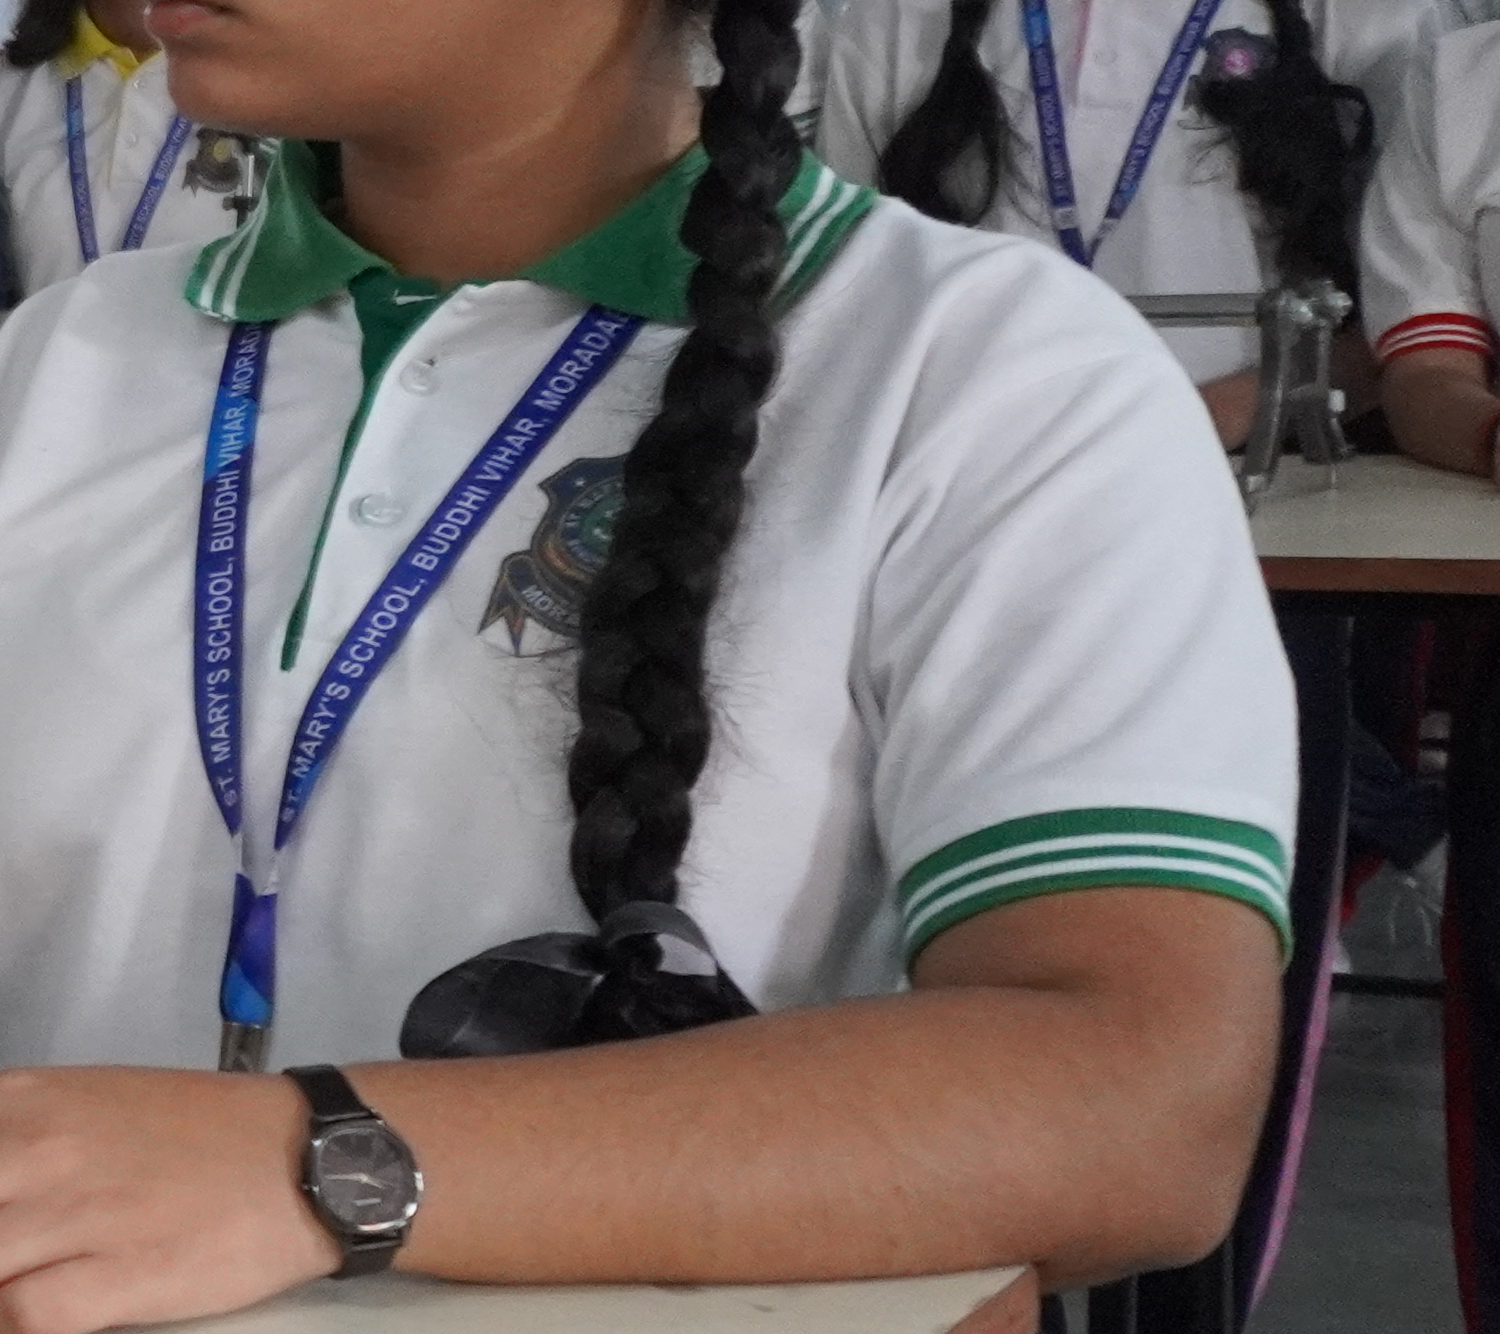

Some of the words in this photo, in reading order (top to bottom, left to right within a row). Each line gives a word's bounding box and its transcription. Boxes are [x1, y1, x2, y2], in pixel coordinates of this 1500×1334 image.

[229, 324, 263, 398] MORAD
[218, 399, 249, 467] VIHAR,
[210, 468, 240, 553] BUDDHI
[291, 681, 351, 779] MARY'S
[338, 578, 428, 679] SCHOOL,
[411, 485, 492, 572] BUDDHI
[476, 417, 551, 482] VIHAR,
[533, 313, 629, 411] MORADA
[207, 556, 238, 663] SCHOOL,
[206, 668, 231, 763] MARY'S
